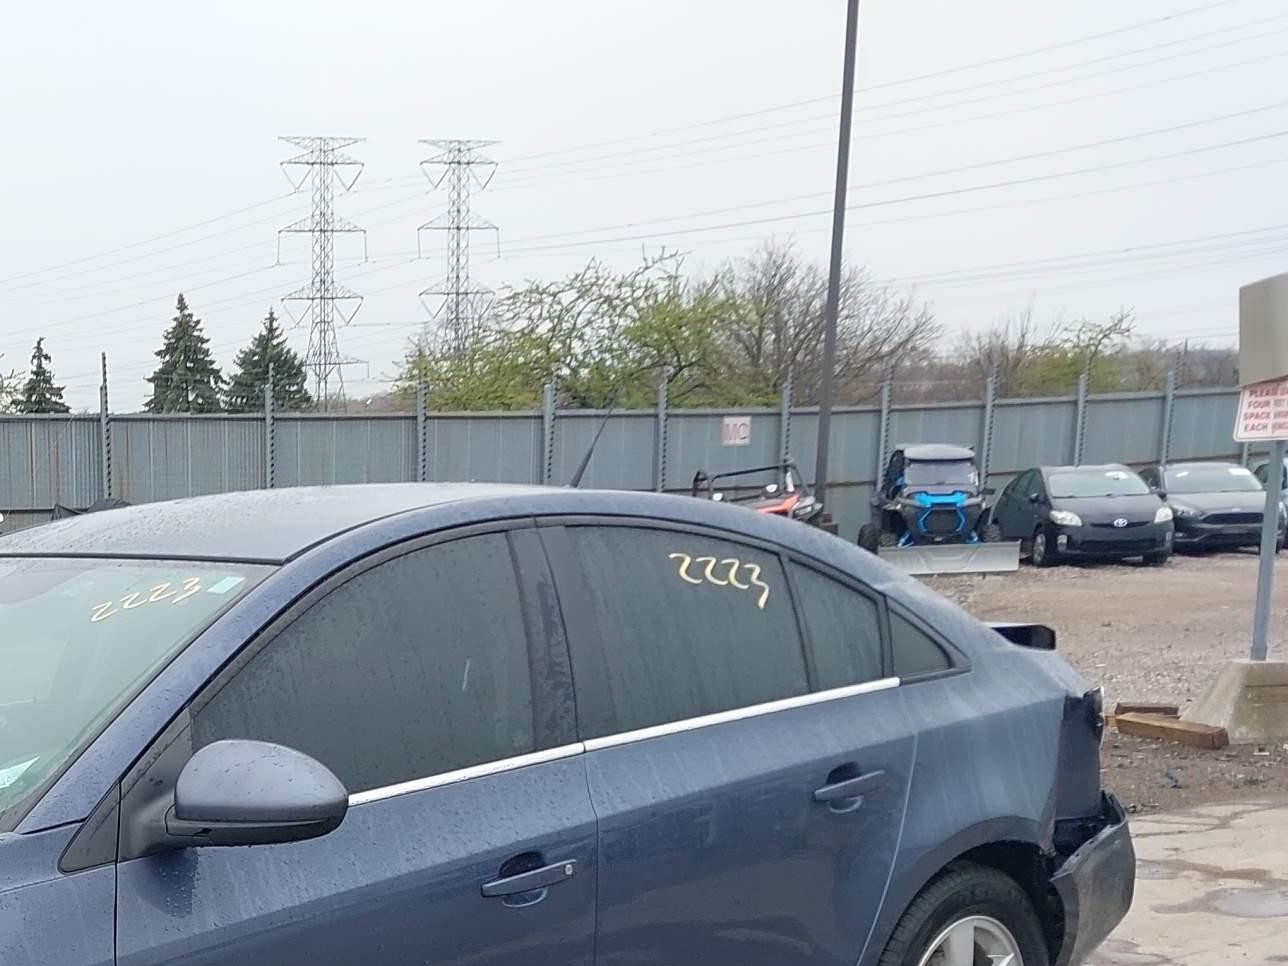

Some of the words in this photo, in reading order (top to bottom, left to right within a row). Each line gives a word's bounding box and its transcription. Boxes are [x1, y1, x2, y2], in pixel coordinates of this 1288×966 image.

[1248, 400, 1271, 409] FOUR
[1243, 411, 1271, 421] SPACE
[1244, 423, 1268, 432] EACH
[669, 553, 769, 609] 2223
[90, 577, 201, 622] 2223
